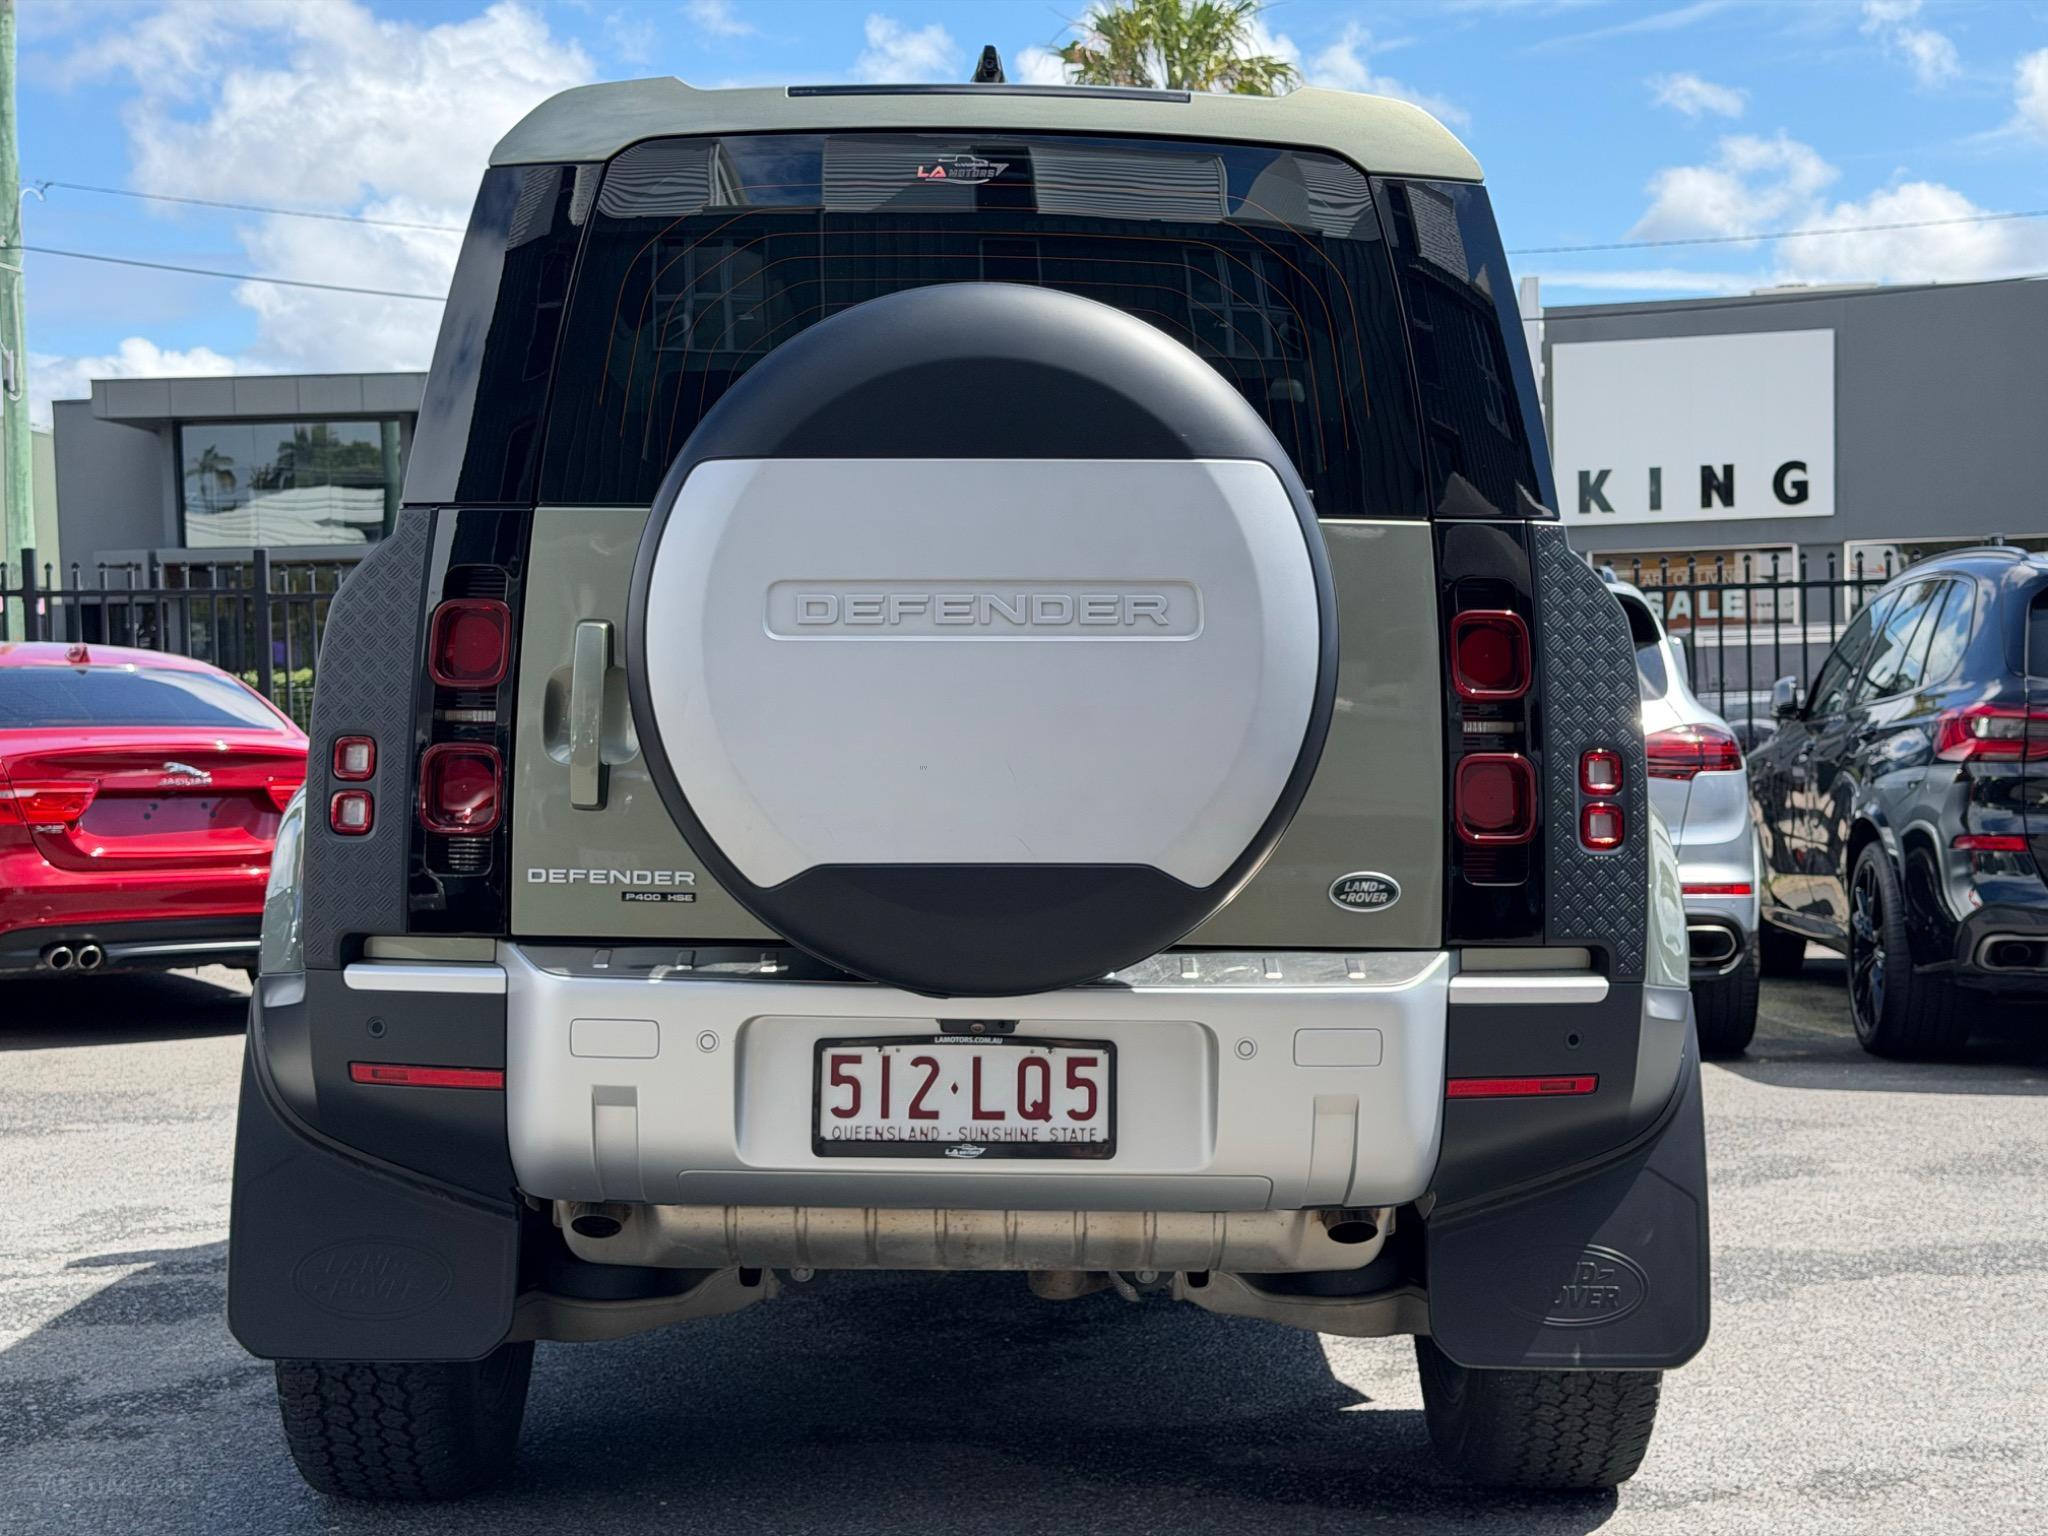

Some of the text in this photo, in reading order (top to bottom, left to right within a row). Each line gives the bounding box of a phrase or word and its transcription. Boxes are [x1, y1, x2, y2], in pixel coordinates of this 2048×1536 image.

[917, 165, 995, 178] LA MOTORS
[1578, 460, 1809, 514] KING
[797, 593, 1170, 626] DEFENDER
[527, 868, 696, 886] DEFENDER
[1344, 881, 1378, 892] LAND
[625, 893, 694, 902] P400 HSE
[1346, 892, 1389, 903] ROVER
[934, 1036, 1003, 1044] LAMOTORS.COM.AU
[832, 1125, 940, 1141] QUEENSLAND
[958, 1126, 1039, 1141] SUNSHINE
[1049, 1127, 1097, 1142] STATE
